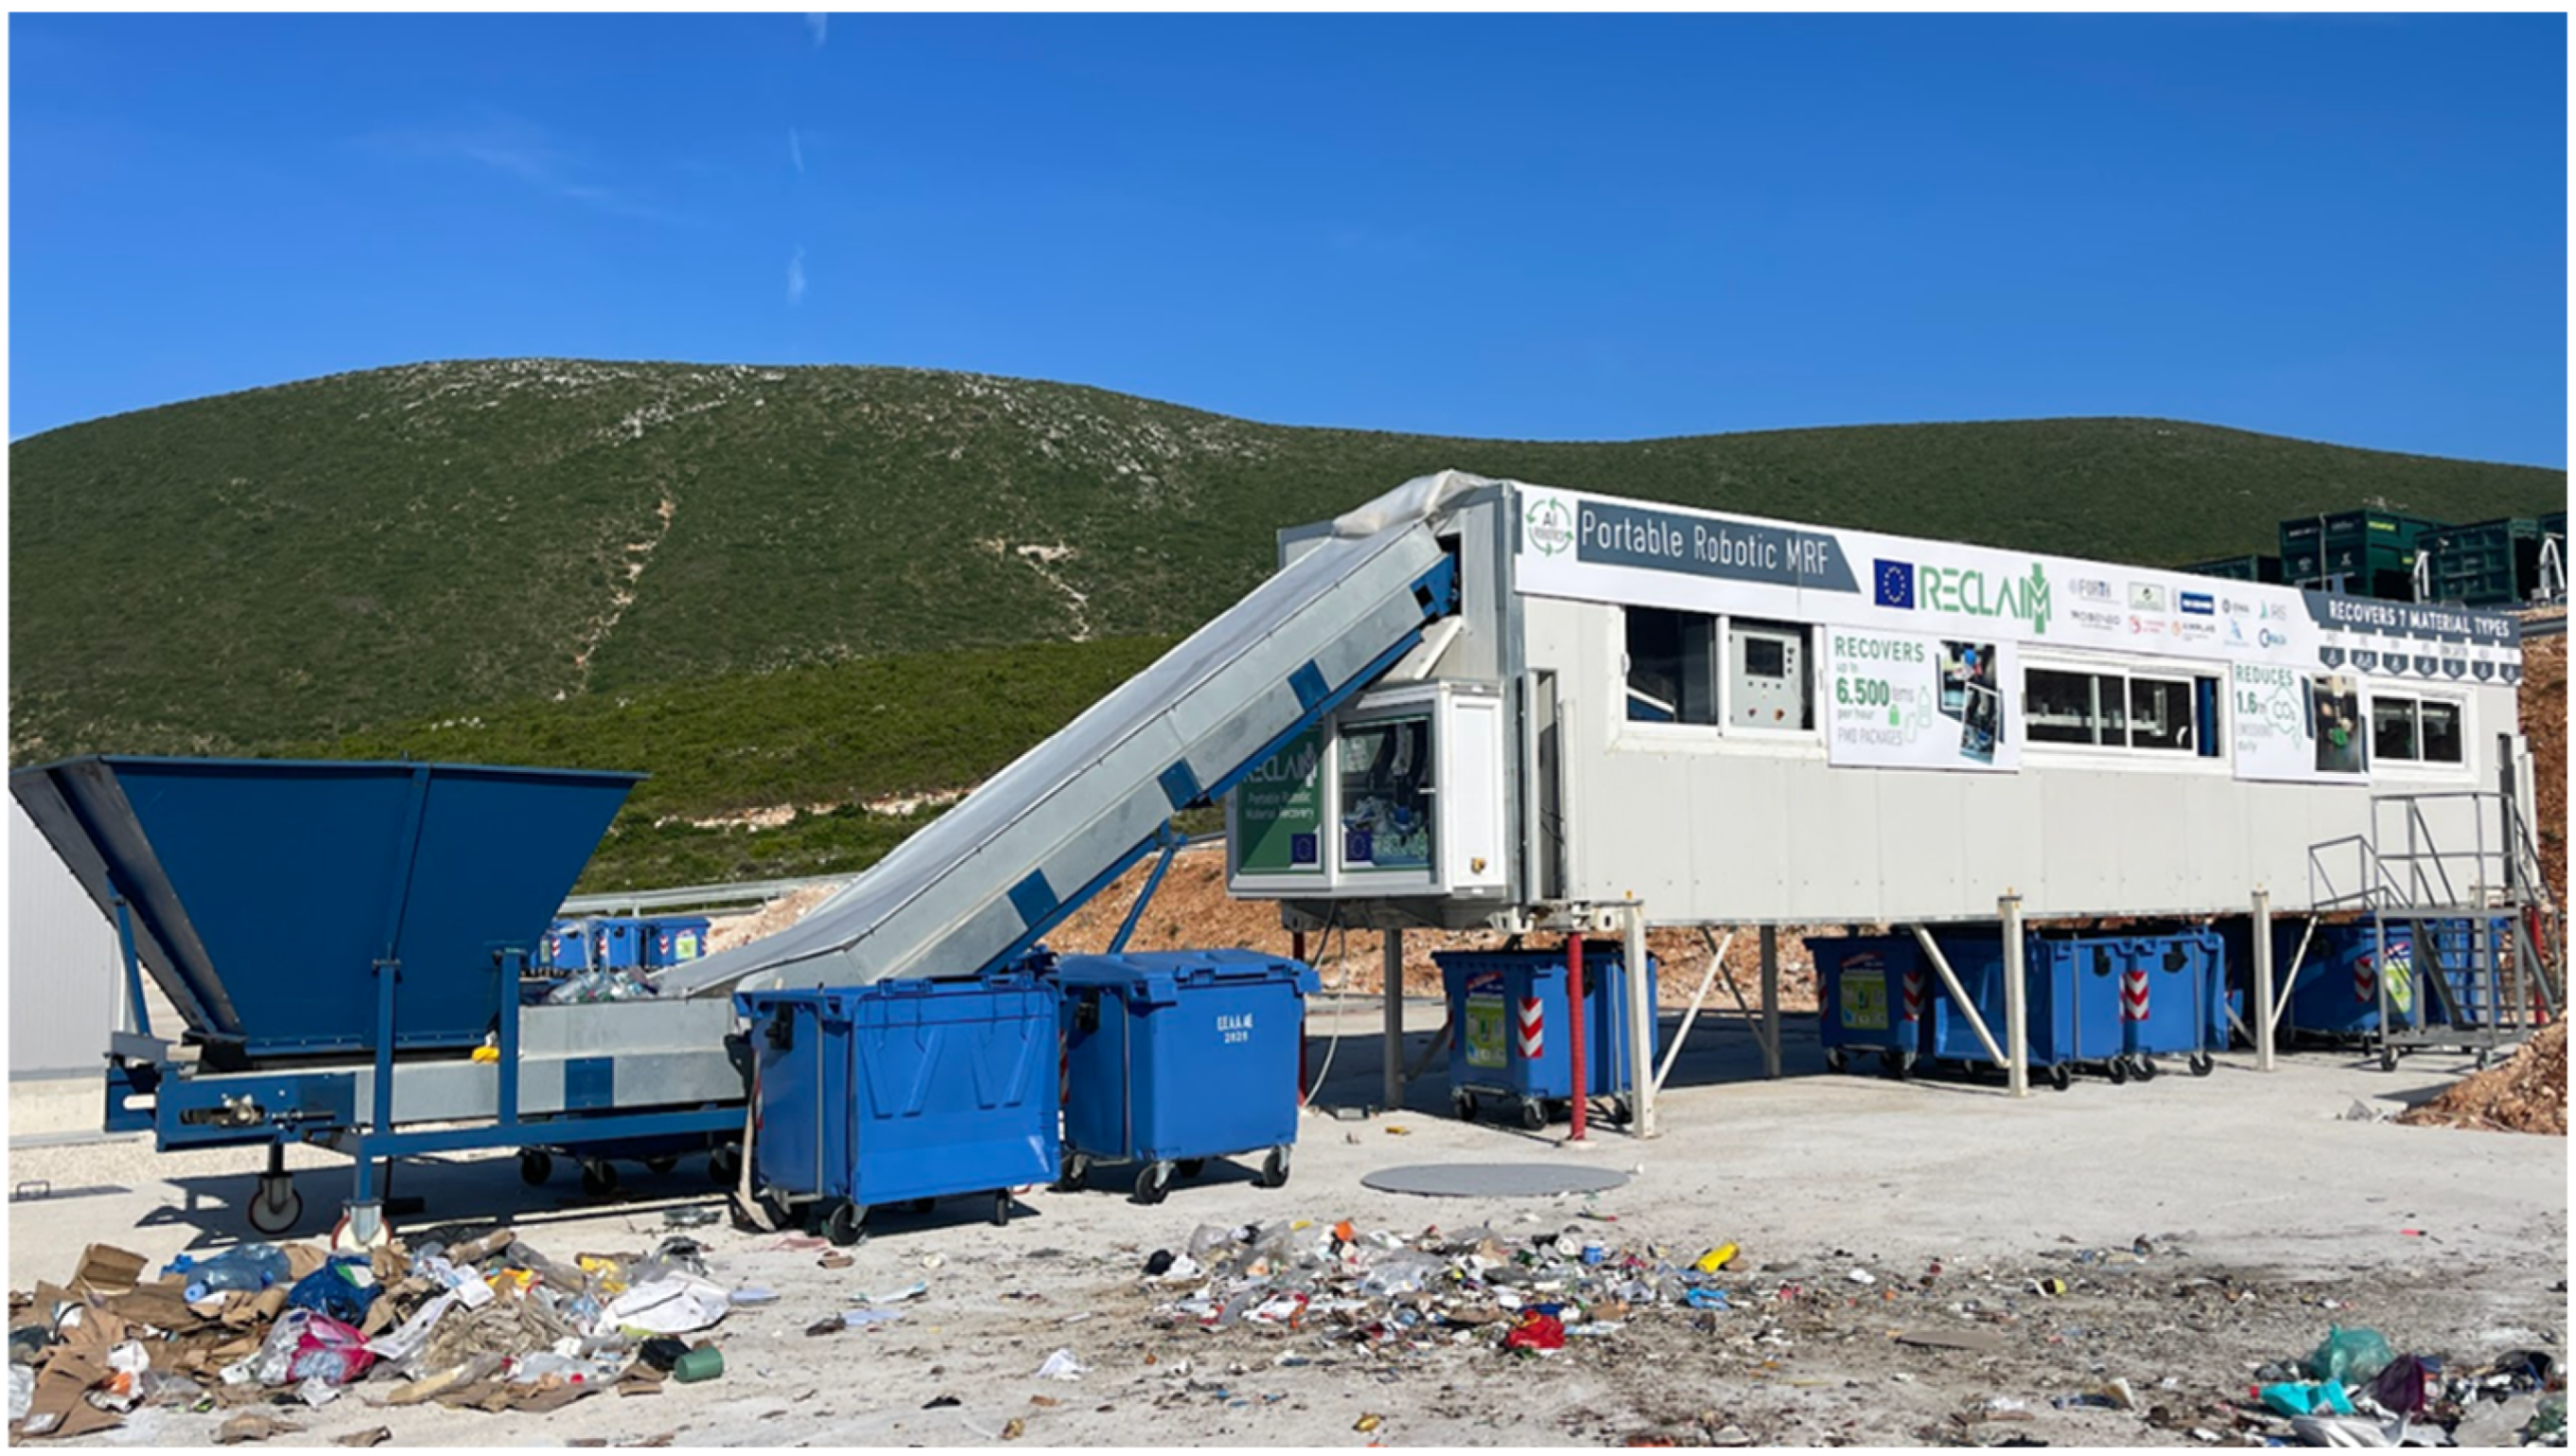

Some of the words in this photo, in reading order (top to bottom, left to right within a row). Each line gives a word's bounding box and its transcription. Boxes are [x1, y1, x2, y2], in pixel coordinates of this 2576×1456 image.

[1581, 510, 1684, 557] Portable
[1693, 525, 1778, 570] Robotic
[1786, 537, 1829, 575] MRF
[1919, 562, 2051, 634] RECLAIM
[2329, 599, 2395, 626] RECOVERS
[2399, 609, 2406, 628] 7
[2409, 610, 2470, 634] MATERIAL
[2473, 617, 2510, 638] TYPES
[1834, 635, 1925, 663] RECOVERS
[1835, 676, 1890, 708] 6.500
[2235, 663, 2294, 688] REDUCES
